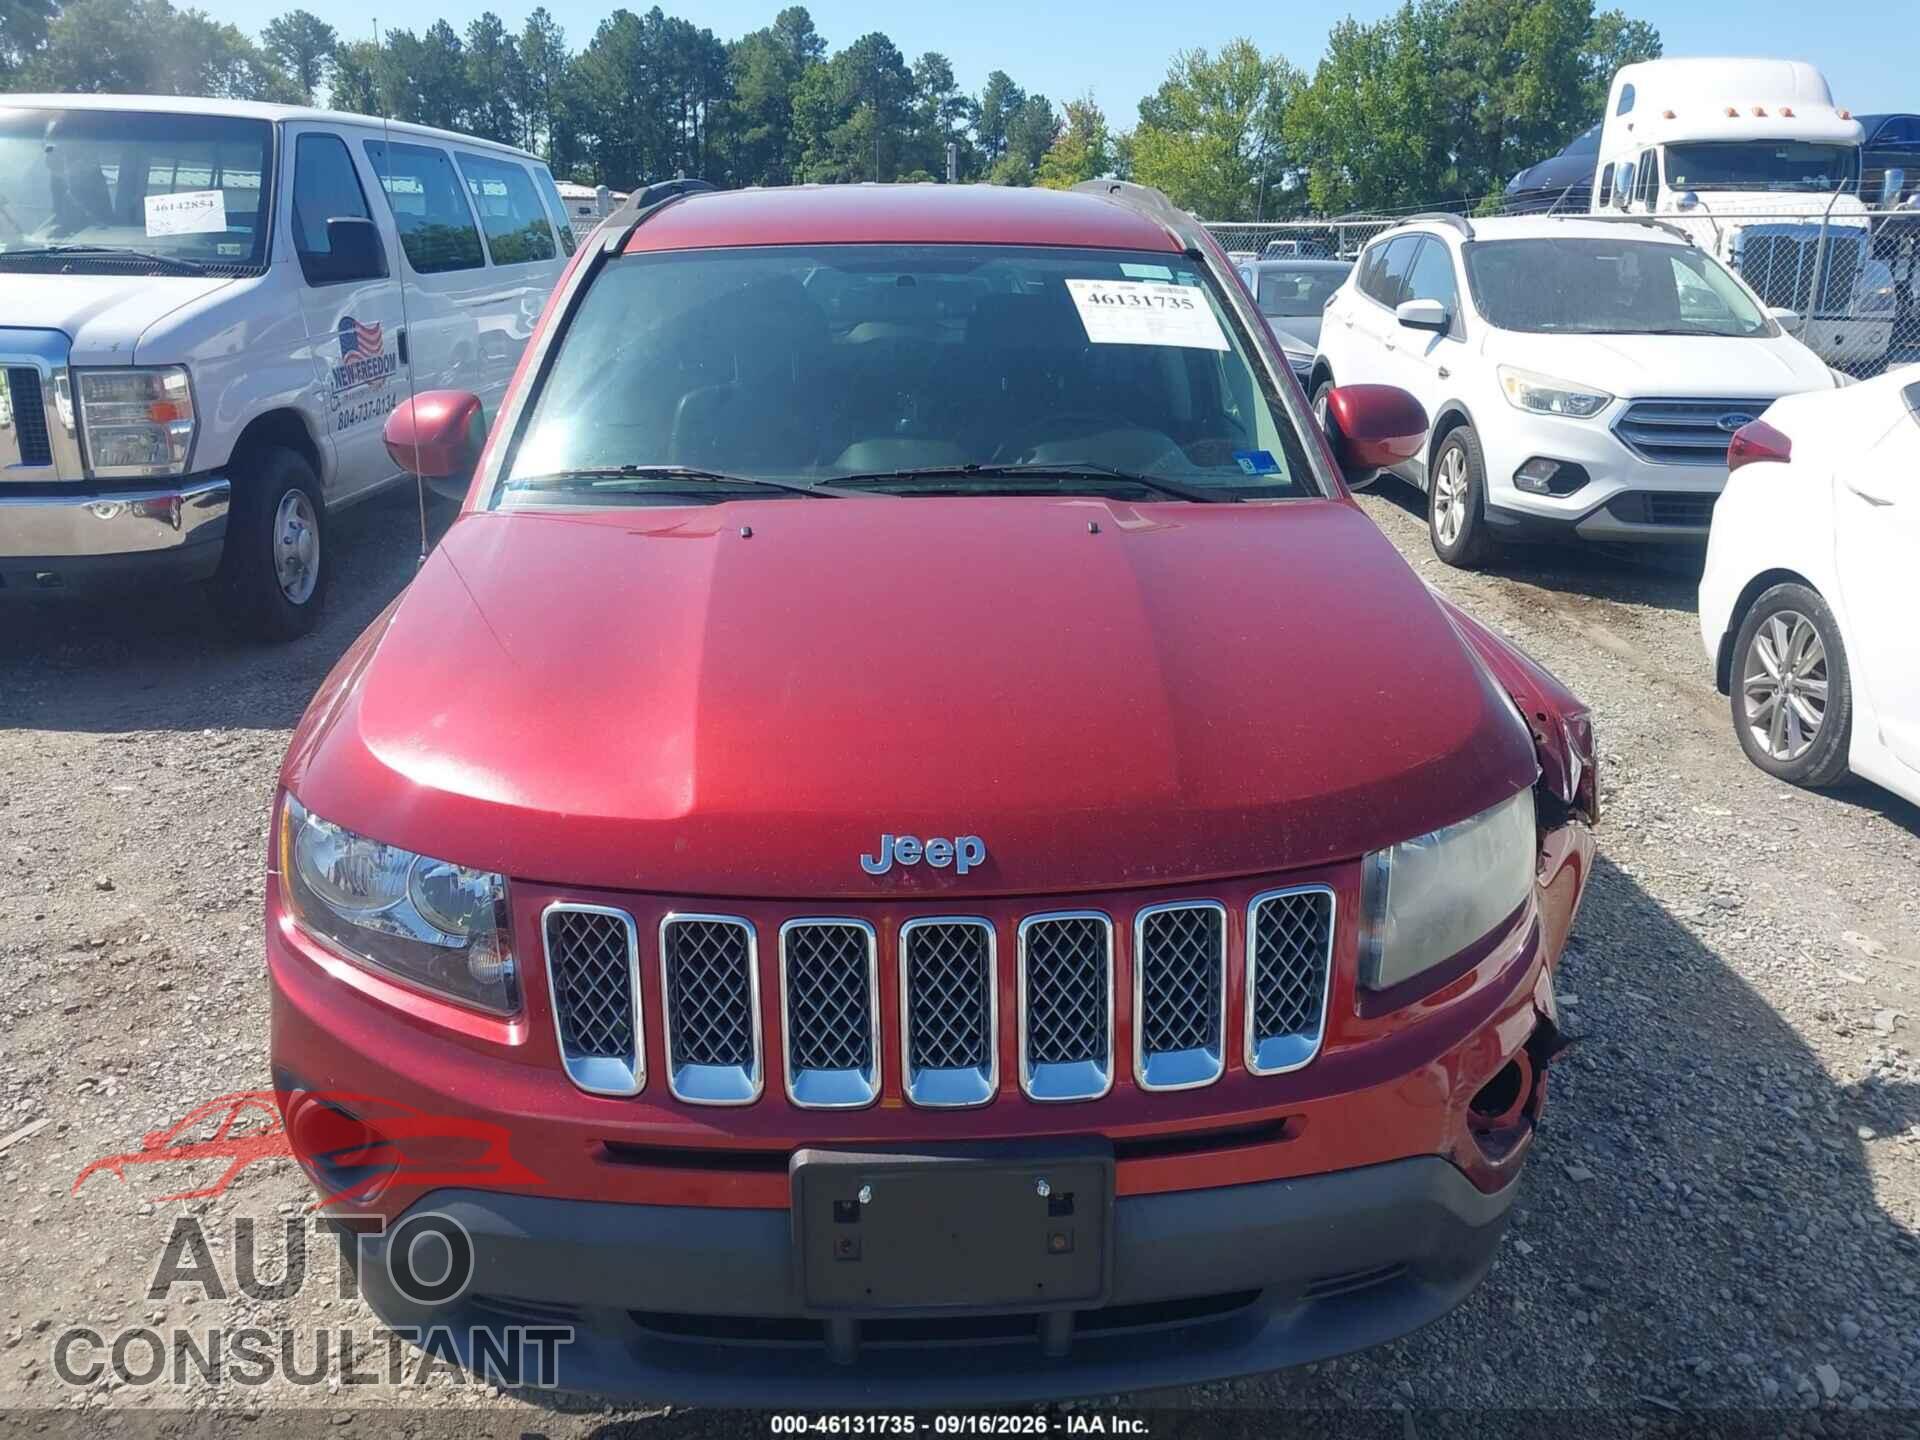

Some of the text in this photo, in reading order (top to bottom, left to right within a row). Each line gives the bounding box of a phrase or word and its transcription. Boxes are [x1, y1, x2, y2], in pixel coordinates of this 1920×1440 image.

[152, 199, 214, 212] 46142854
[1088, 292, 1195, 310] 46131735
[356, 352, 397, 381] FREEDOM
[337, 393, 397, 431] 804-737-0134
[859, 833, 986, 875] Jeep
